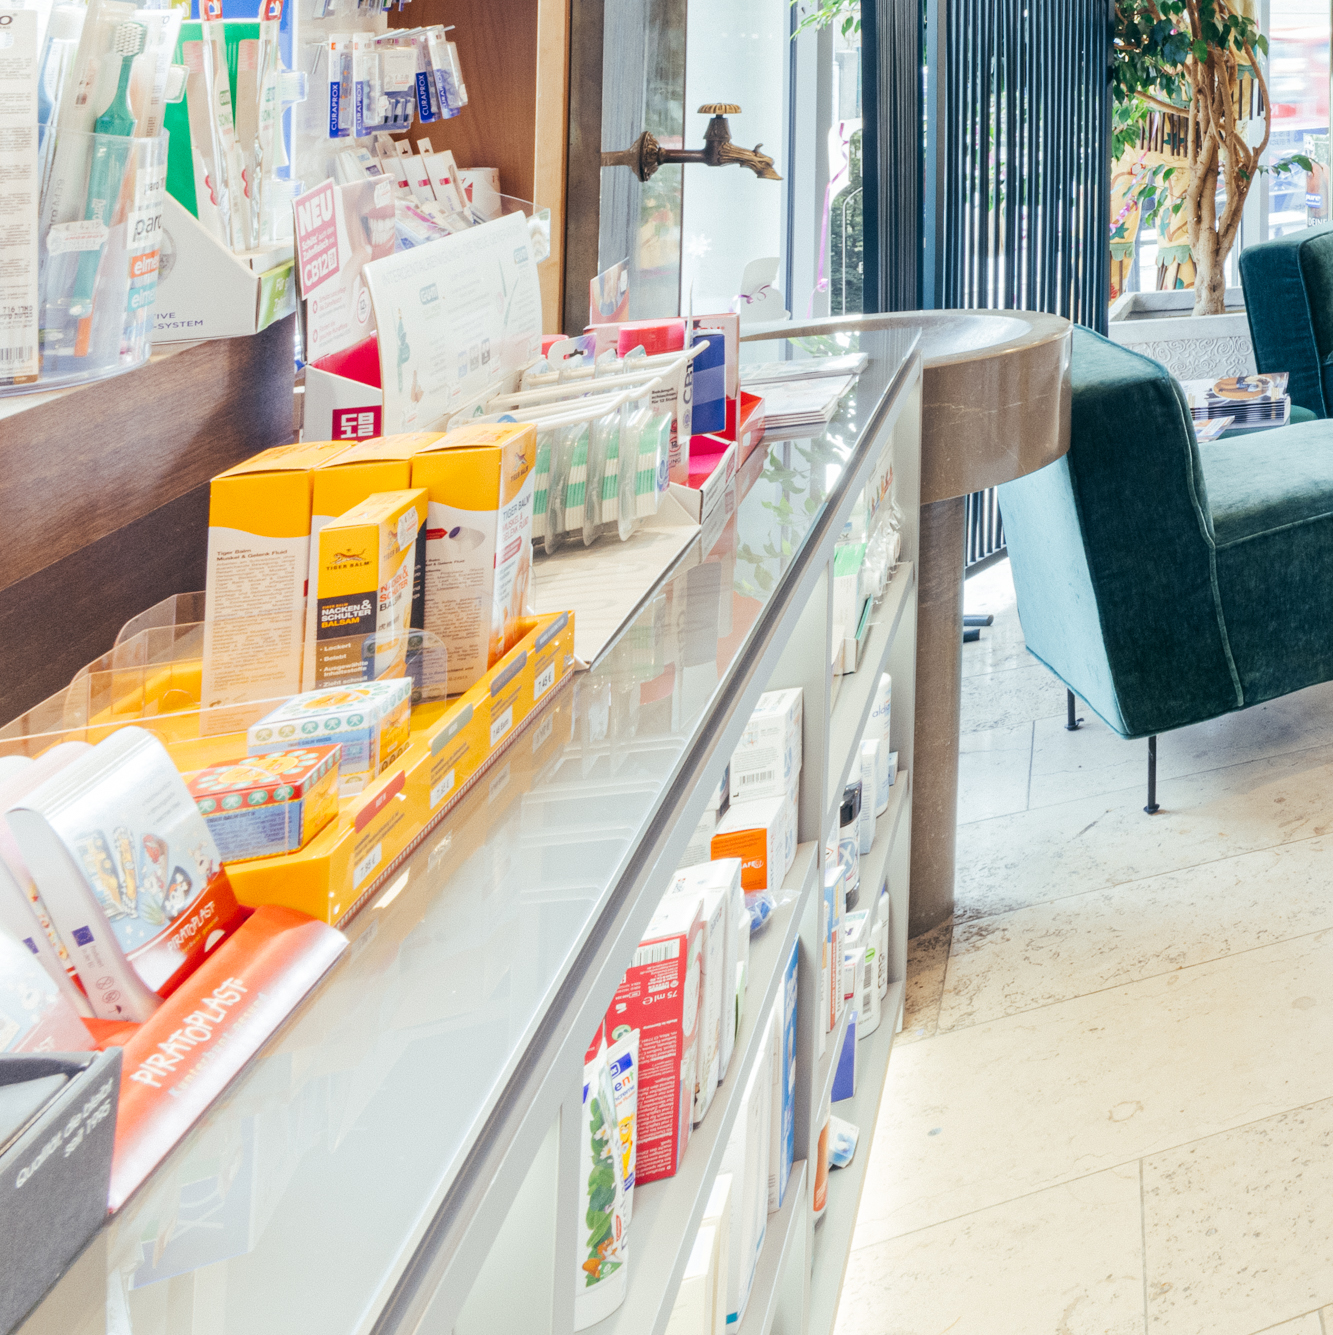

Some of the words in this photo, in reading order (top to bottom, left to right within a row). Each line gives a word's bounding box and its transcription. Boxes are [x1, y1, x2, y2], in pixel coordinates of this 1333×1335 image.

[417, 74, 429, 116] CURAPROX
[331, 84, 339, 131] CURAPROX
[355, 83, 363, 130] CURAPROX
[297, 189, 333, 236] NEU
[304, 254, 330, 287] CB12
[503, 503, 518, 522] TIGER
[518, 492, 532, 513] BALM
[350, 560, 371, 569] BALM
[322, 604, 360, 616] NACKEN
[361, 599, 372, 610] &
[321, 609, 372, 623] SCHULTER
[321, 617, 360, 629] BALSAM
[324, 642, 352, 652] Lockert
[324, 654, 347, 662] Belebt
[324, 660, 368, 672] Ausgewählte
[324, 666, 368, 677] Inhaltsstoffe
[322, 680, 342, 688] Zieht
[342, 676, 368, 686] schnell
[167, 900, 216, 951] PIRATOPLAST
[654, 992, 666, 1003] ml
[668, 990, 678, 1000] 75
[130, 977, 250, 1088] PIRATOPLAST
